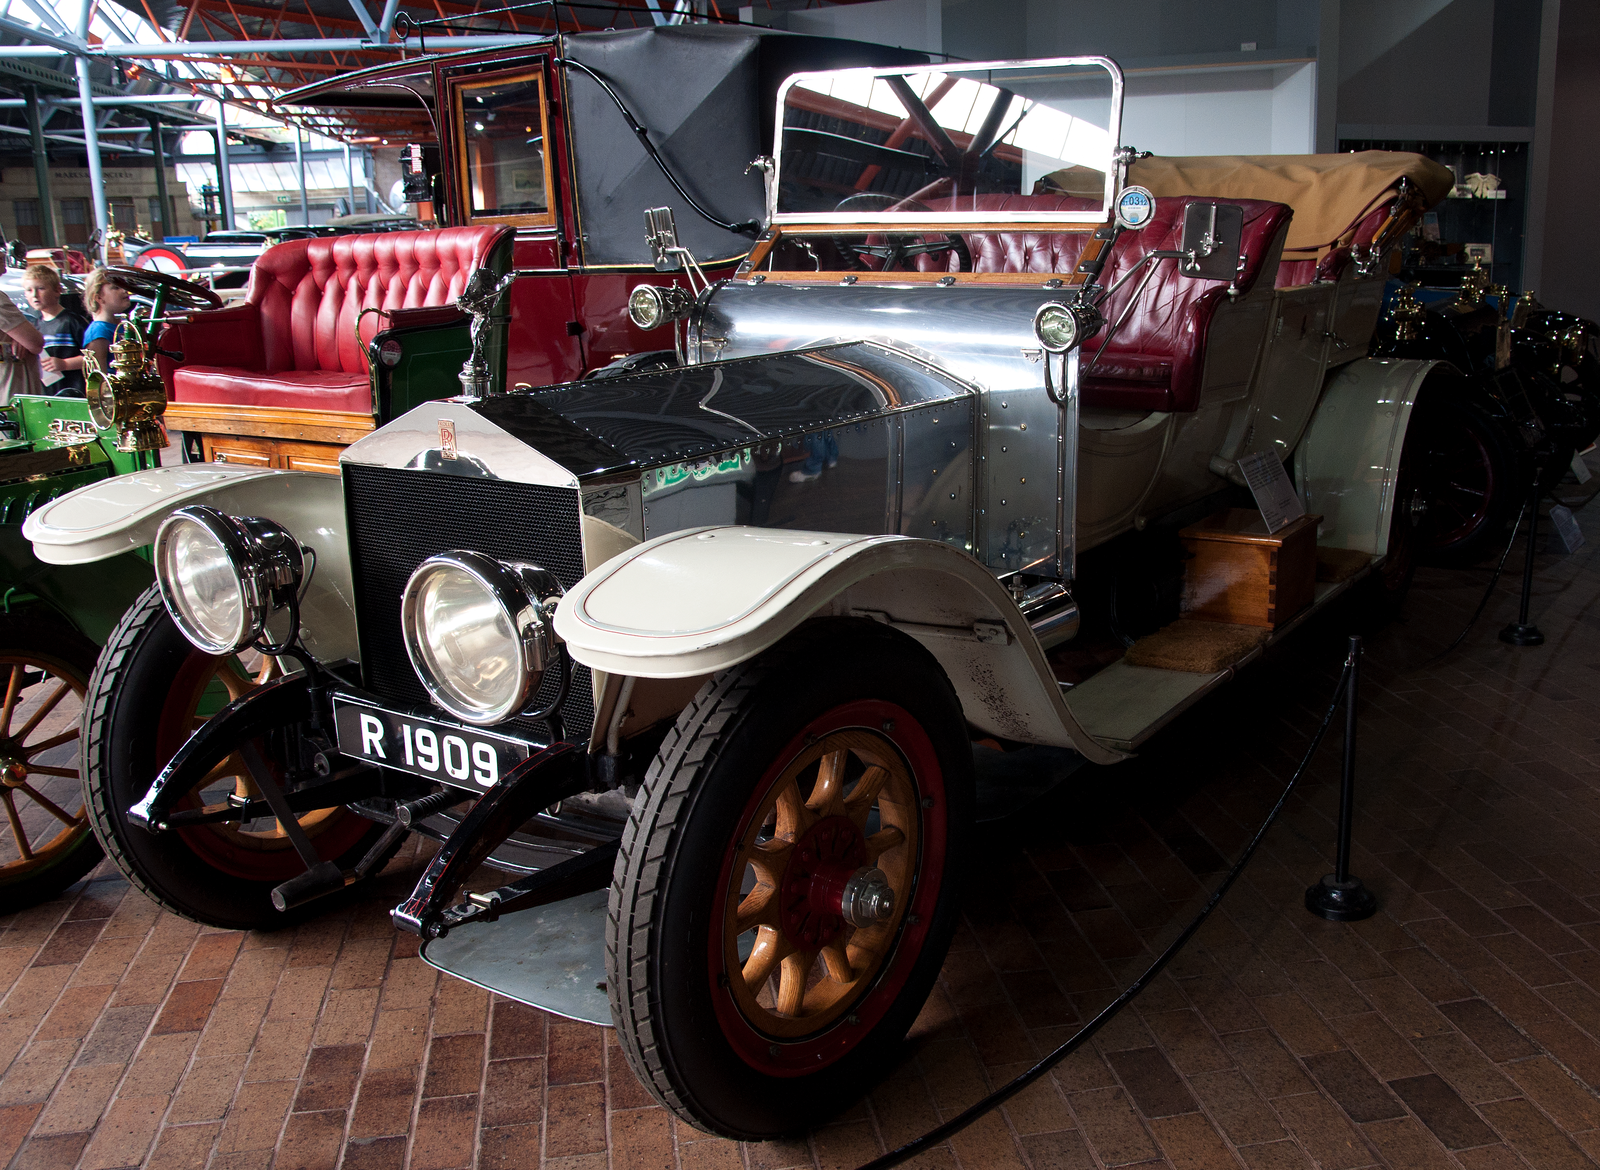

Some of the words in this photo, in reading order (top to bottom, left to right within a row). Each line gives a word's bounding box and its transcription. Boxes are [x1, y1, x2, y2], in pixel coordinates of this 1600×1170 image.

[1129, 196, 1140, 206] 03
[360, 712, 387, 759] R
[402, 723, 499, 788] 1909
